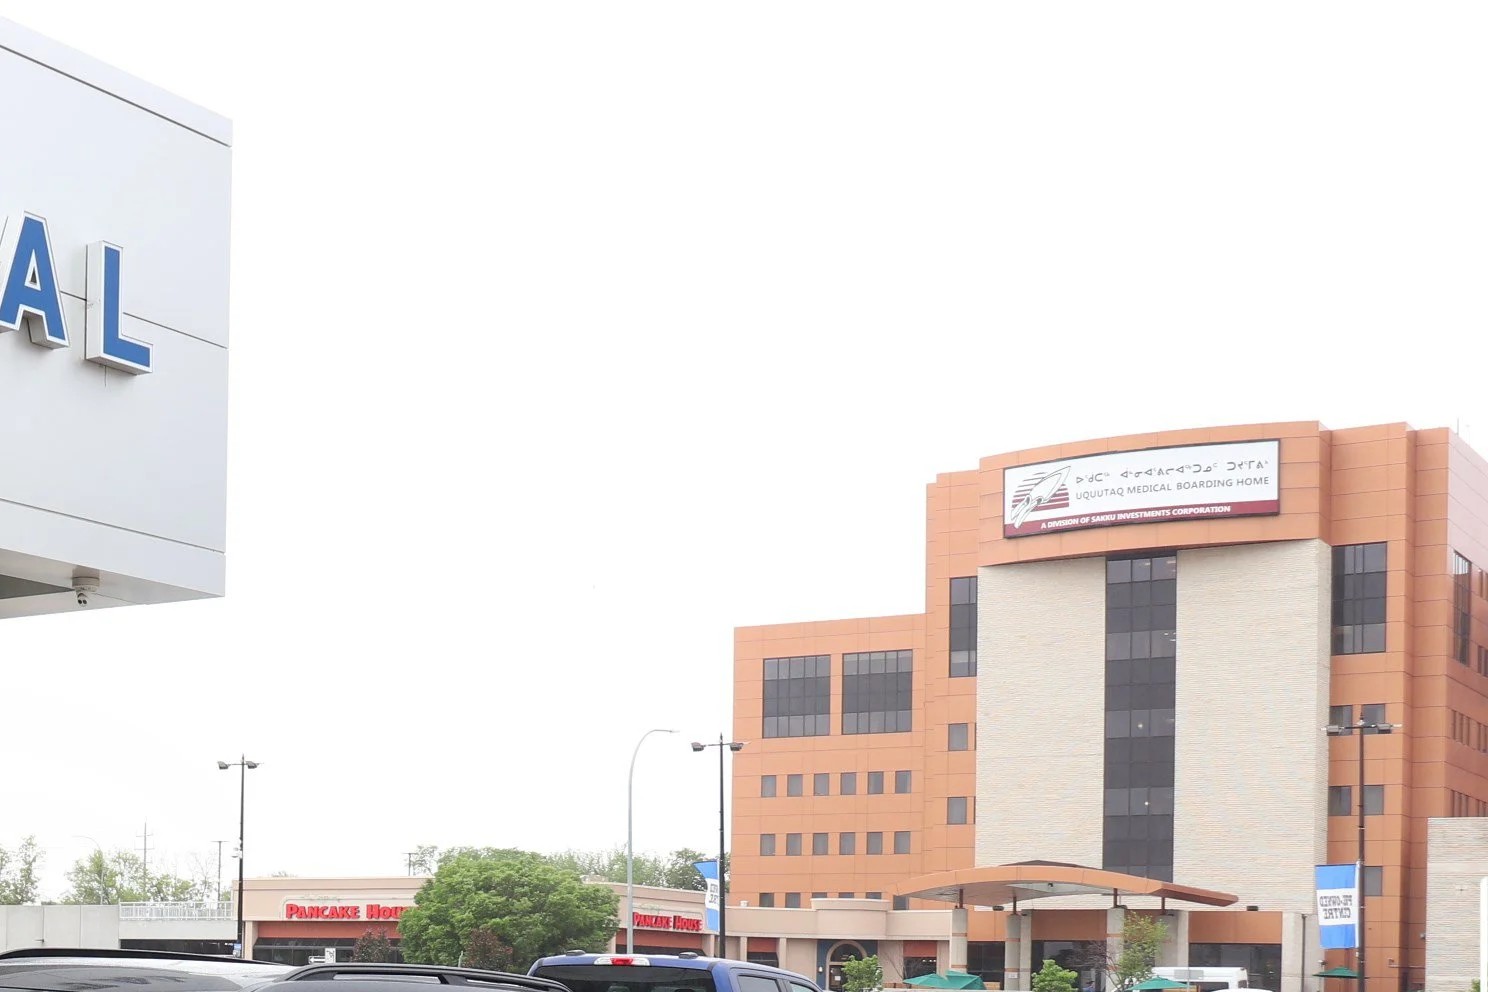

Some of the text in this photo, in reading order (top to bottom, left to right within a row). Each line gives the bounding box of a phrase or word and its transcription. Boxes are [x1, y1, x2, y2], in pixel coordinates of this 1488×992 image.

[1075, 476, 1270, 500] UQUUTAQ MEDICAL BOARDING HOME
[1048, 519, 1079, 529] DIVISION
[1080, 517, 1091, 525] OF
[1091, 514, 1117, 523] SAKKU
[1117, 508, 1171, 520] INVESTMENTS
[1172, 505, 1231, 515] CORPORATION
